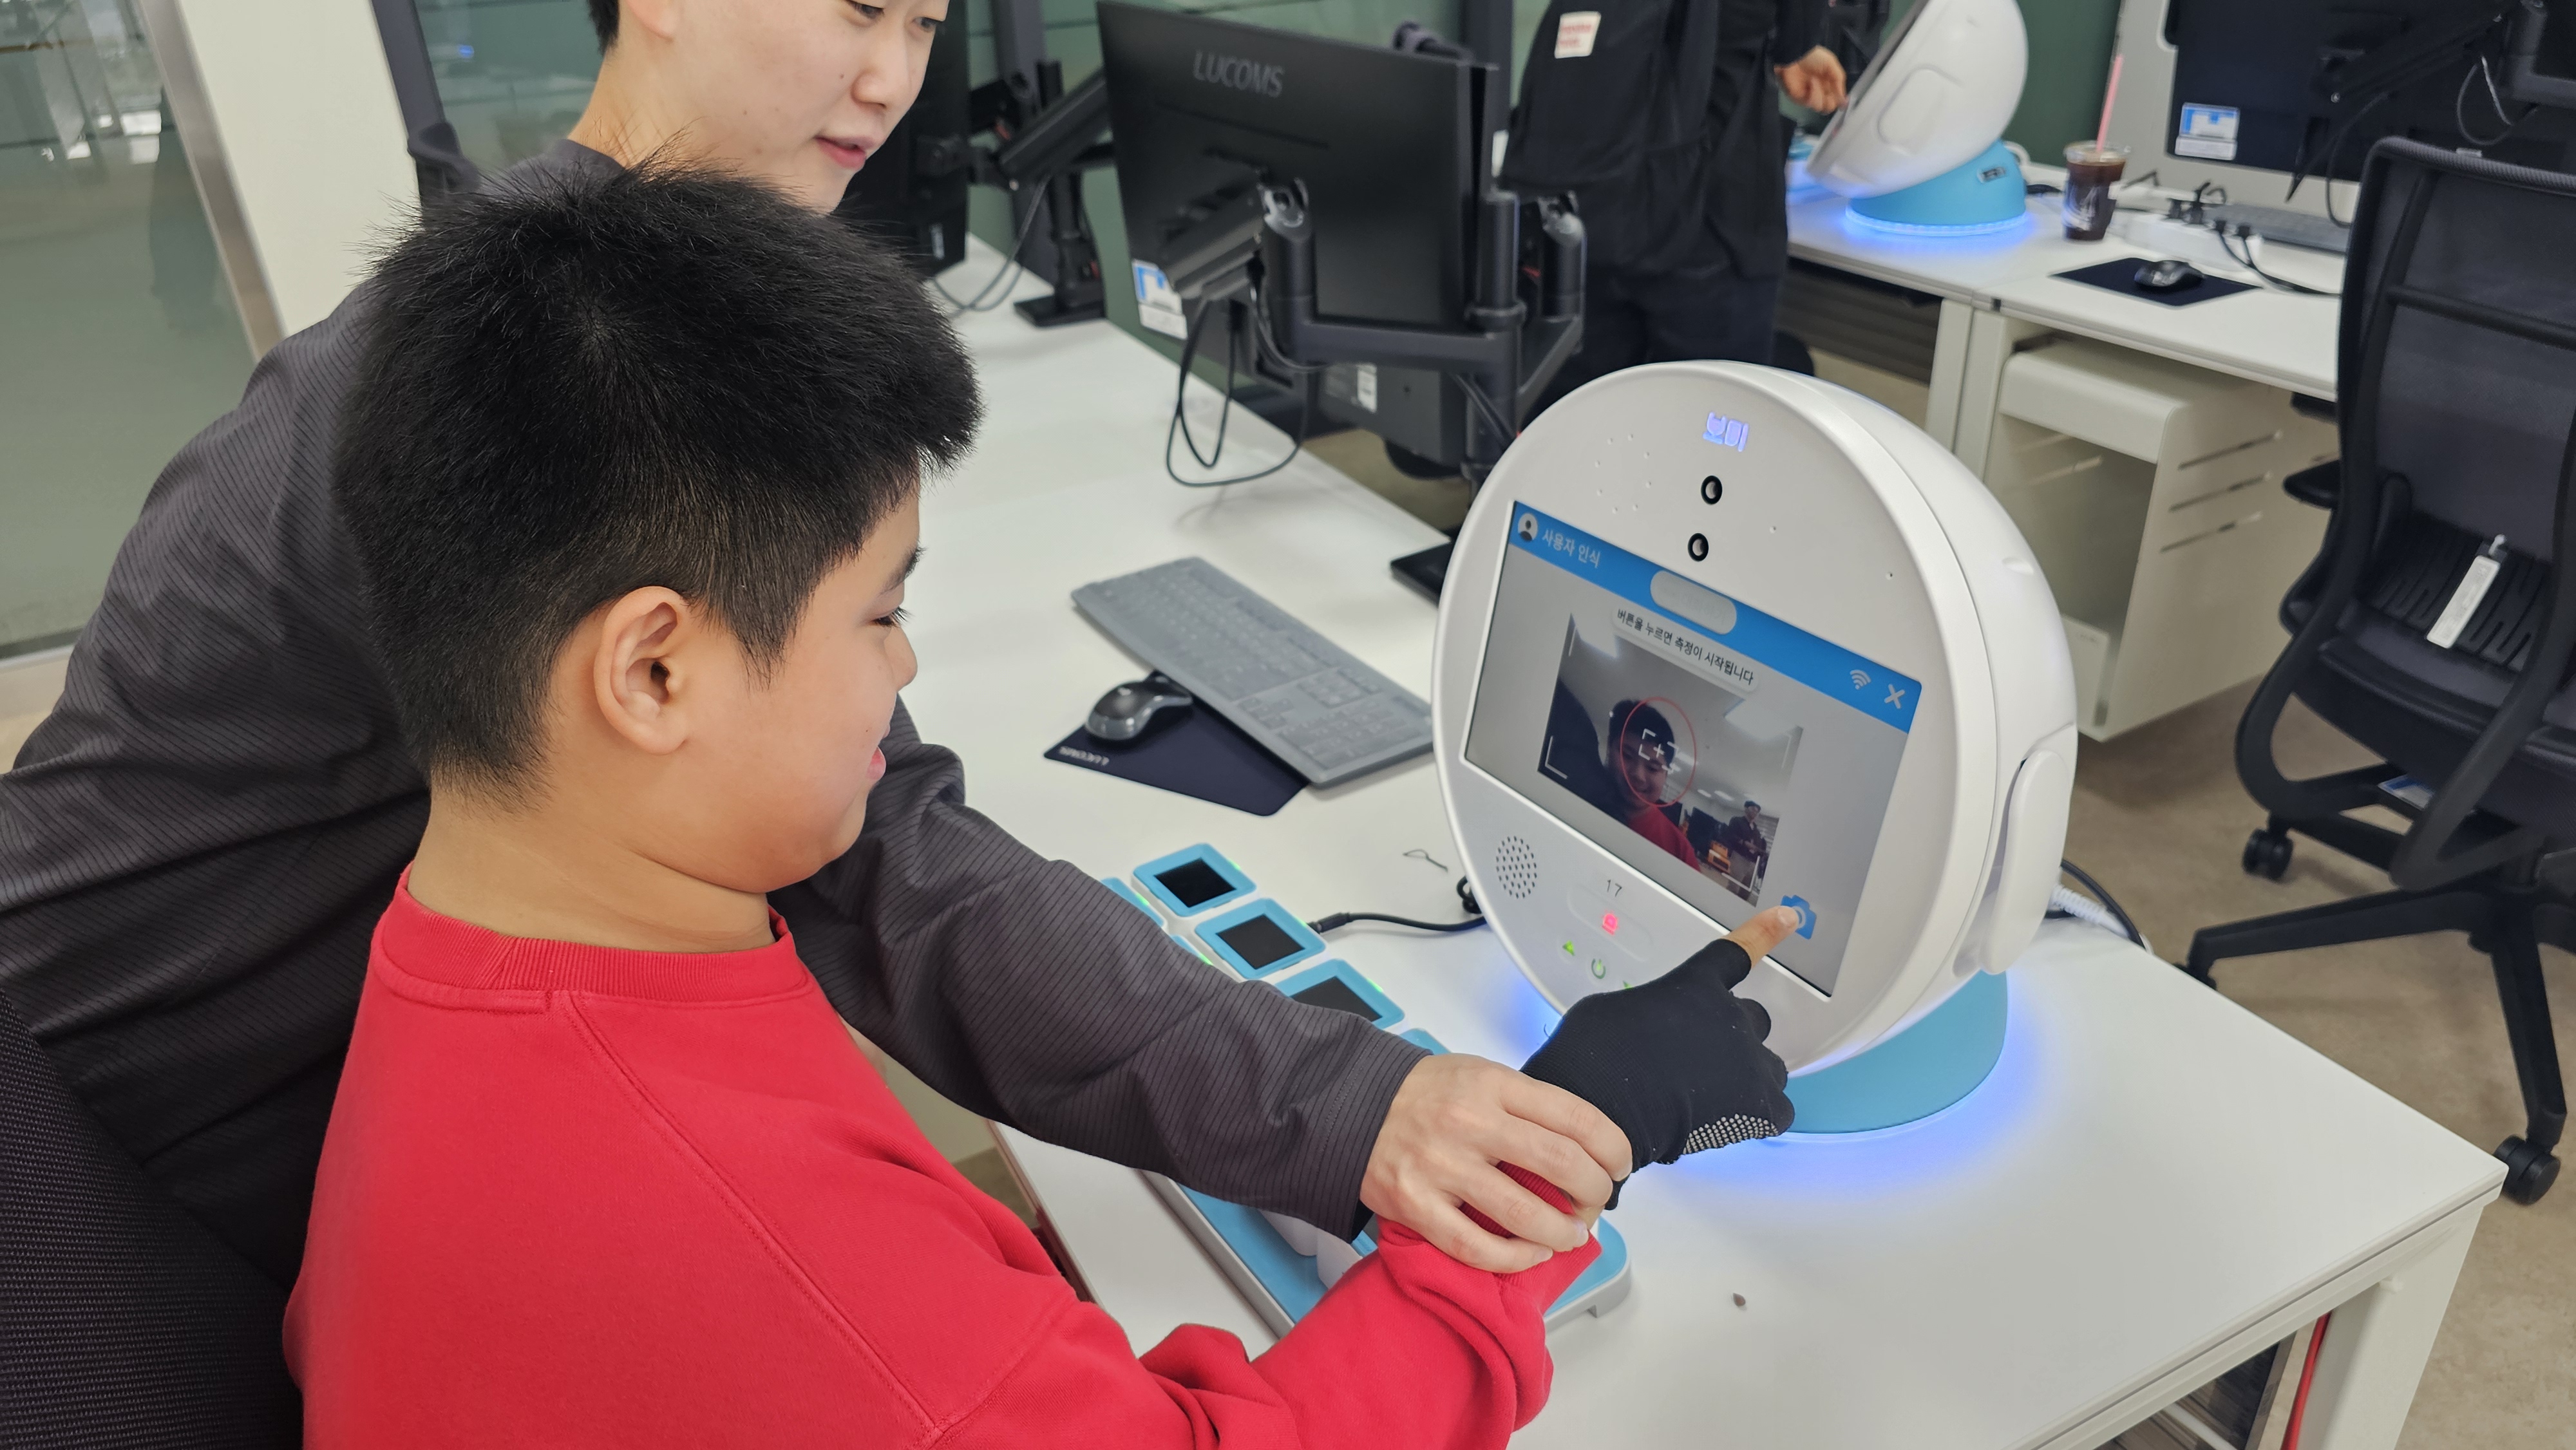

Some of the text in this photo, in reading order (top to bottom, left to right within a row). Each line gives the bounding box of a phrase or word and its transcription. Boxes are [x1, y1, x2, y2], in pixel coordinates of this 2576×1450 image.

[1193, 50, 1285, 98] LUCOMS
[1702, 411, 1749, 452] 보미
[1542, 529, 1600, 569] 사용자 인식
[1617, 608, 1754, 686] 버튼을 누르면 측정이 시작됩니다
[1607, 880, 1622, 898] 17
